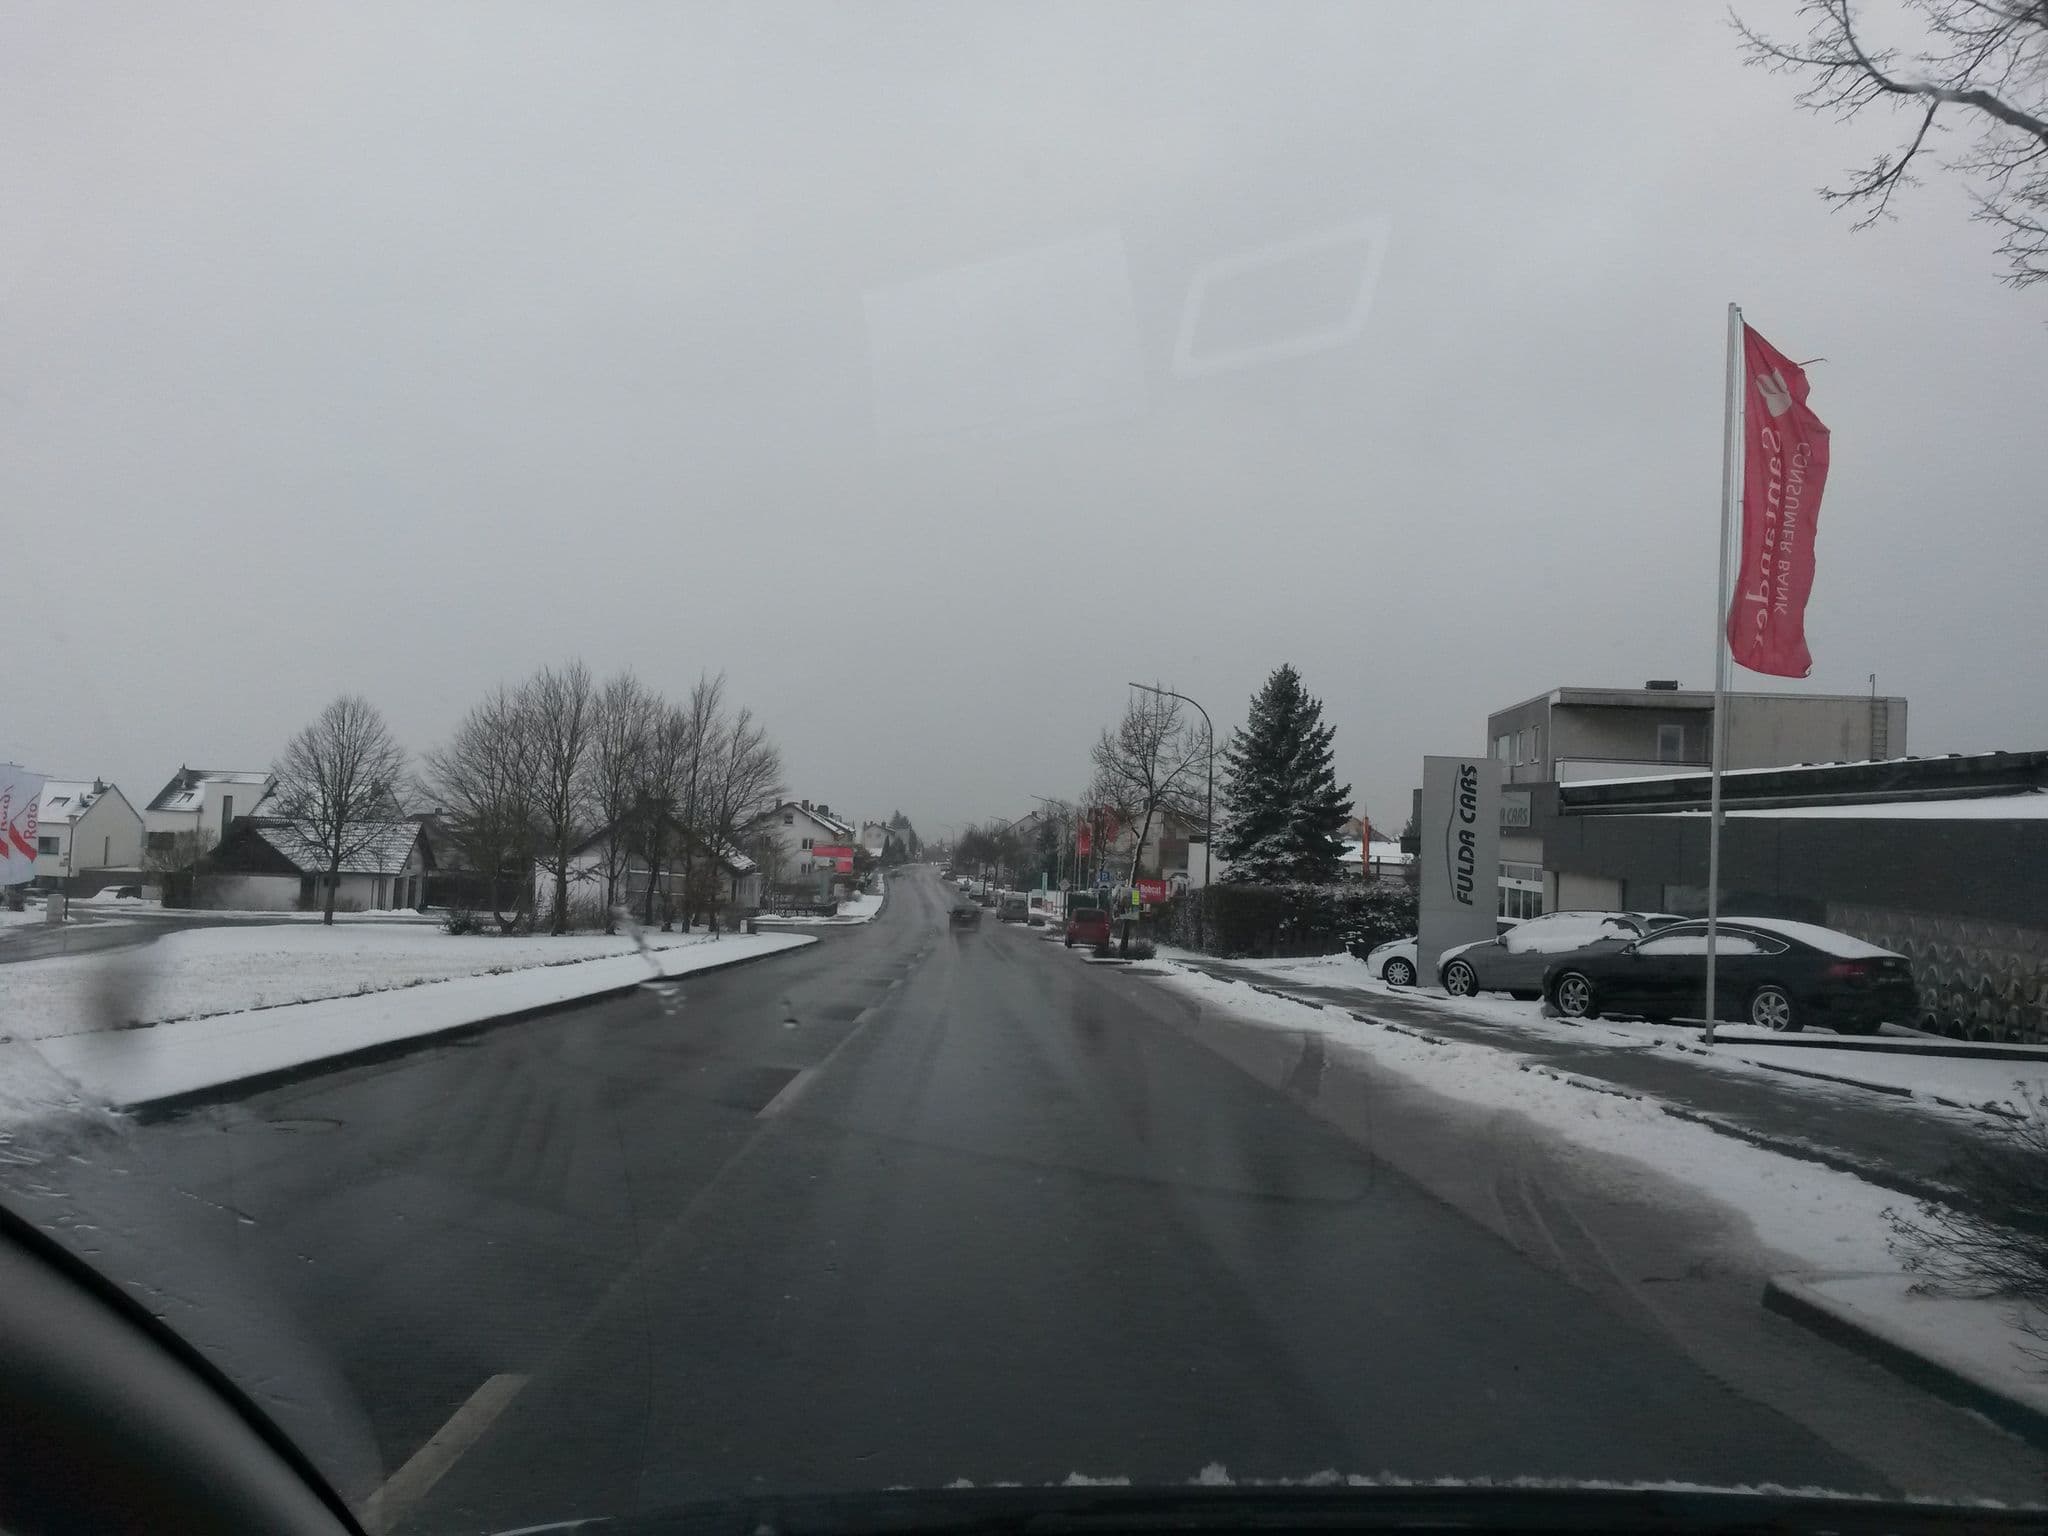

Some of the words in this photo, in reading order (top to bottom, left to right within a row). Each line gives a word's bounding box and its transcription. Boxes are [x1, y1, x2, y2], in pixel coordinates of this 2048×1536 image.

[23, 803, 38, 839] Roto
[1459, 763, 1478, 824] CARS
[1456, 829, 1476, 906] FULDA
